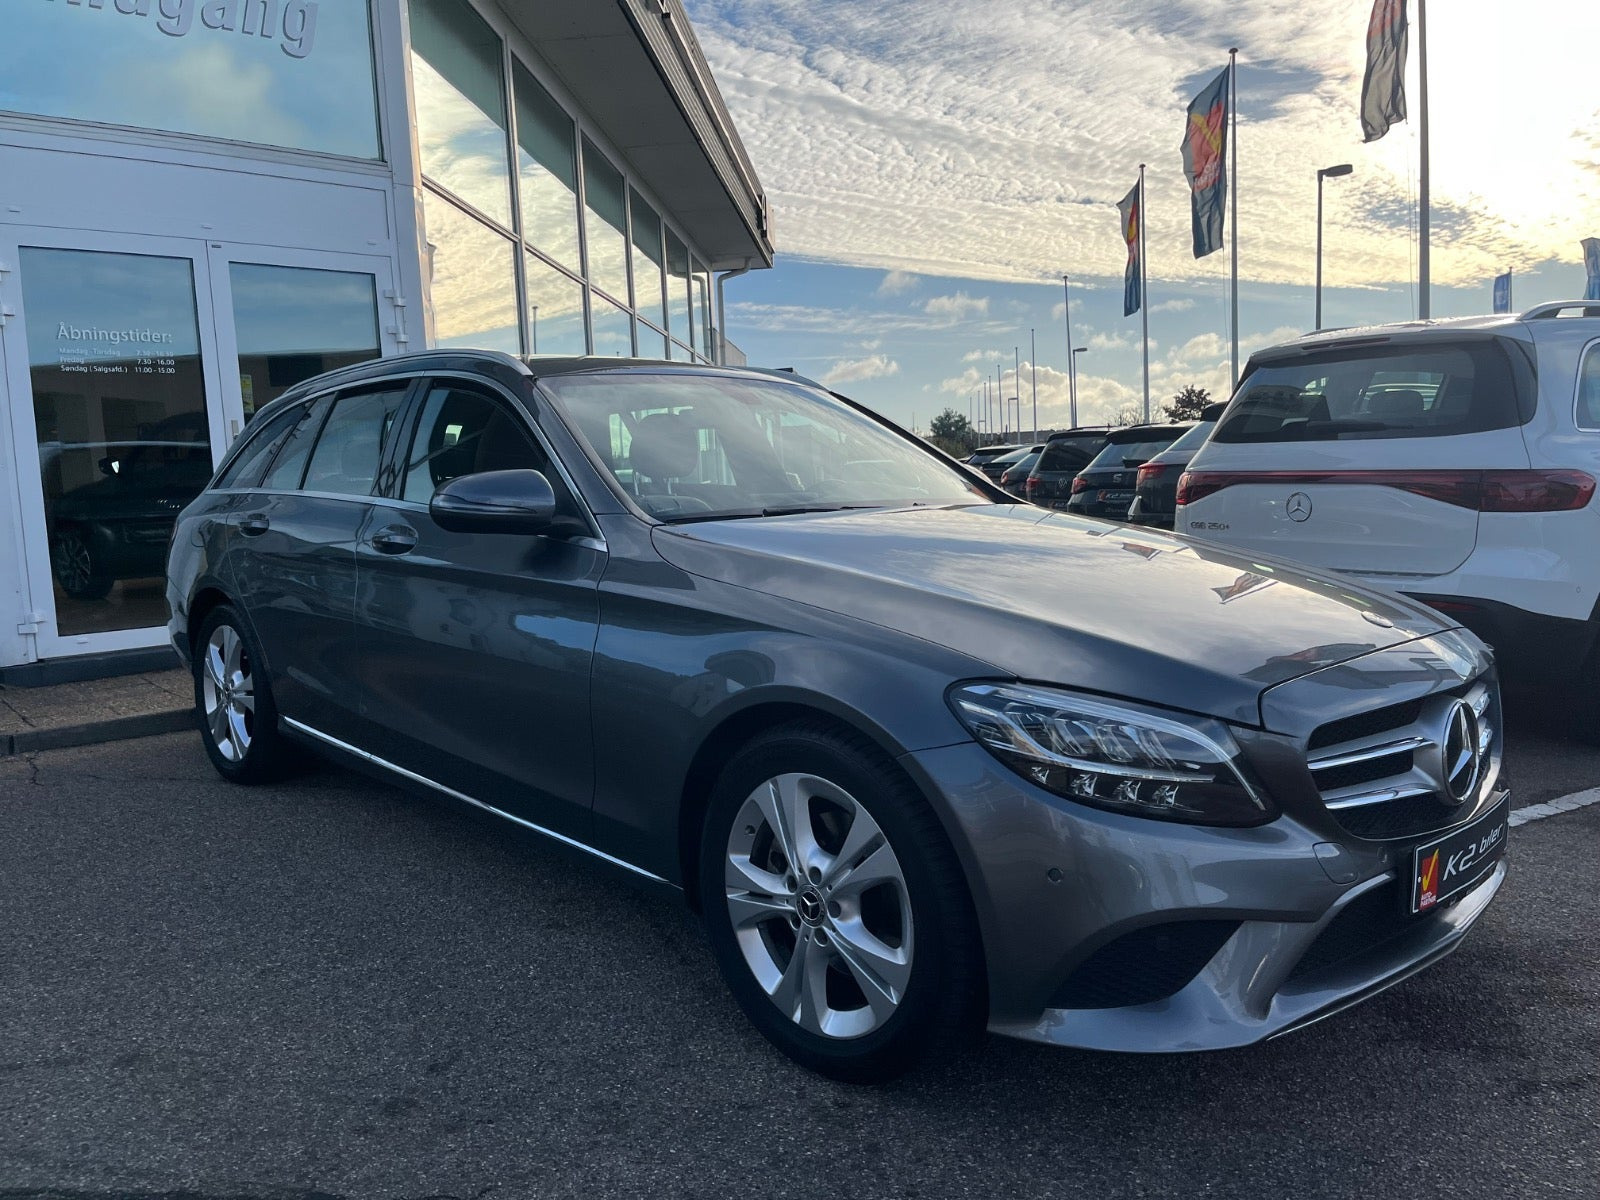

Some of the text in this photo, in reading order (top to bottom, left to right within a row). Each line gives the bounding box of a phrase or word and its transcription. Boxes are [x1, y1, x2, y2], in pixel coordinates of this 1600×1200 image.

[46, 0, 319, 59] gang
[58, 322, 173, 344] Åbningstider:
[60, 365, 88, 373] Søndag
[1443, 843, 1476, 881] K2
